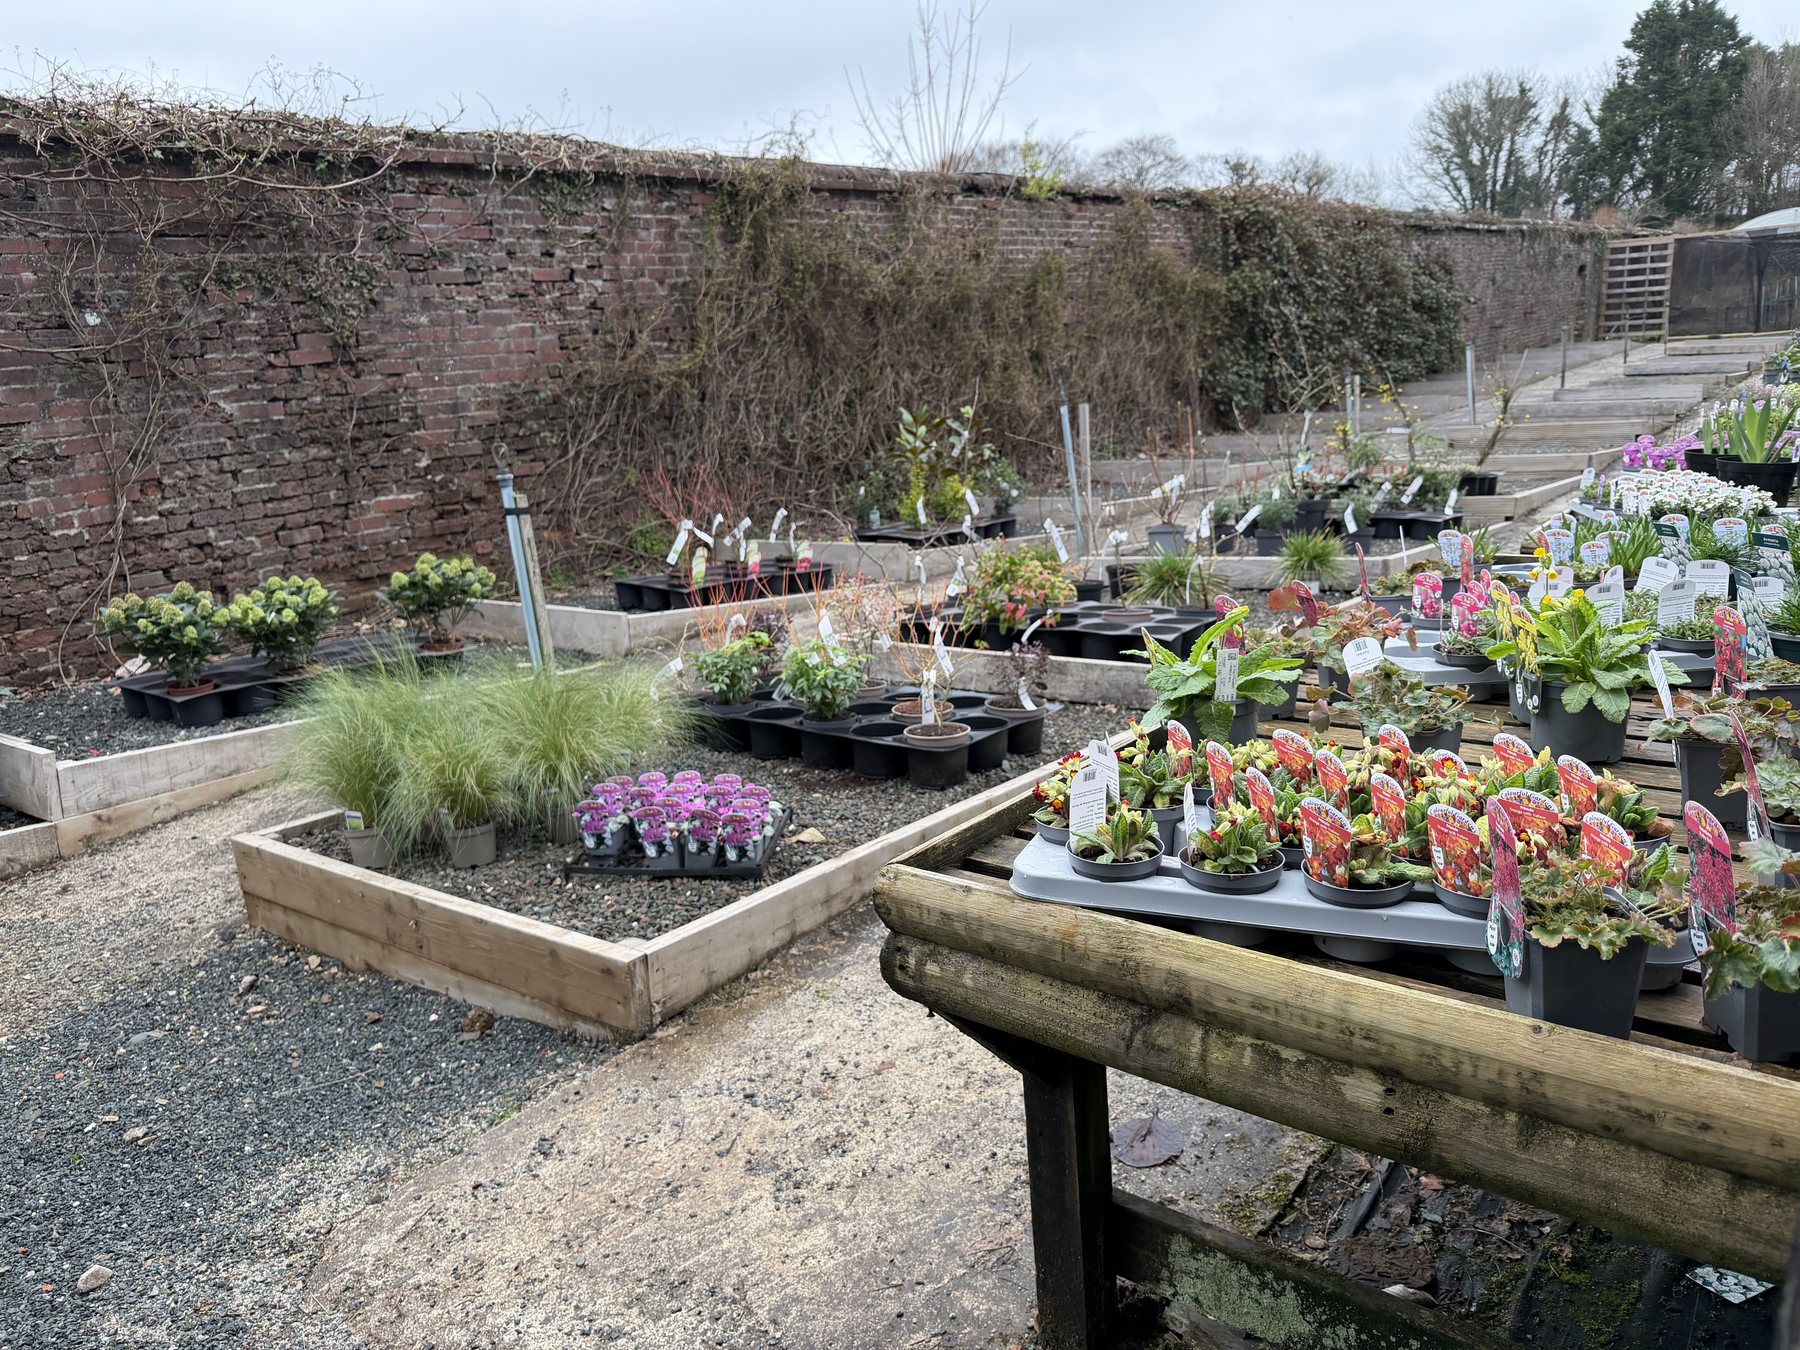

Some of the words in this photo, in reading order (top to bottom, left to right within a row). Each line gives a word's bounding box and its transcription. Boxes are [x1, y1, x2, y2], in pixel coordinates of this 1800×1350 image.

[1500, 790, 1530, 799] Colourful
[1429, 807, 1454, 815] Colourful
[1585, 815, 1610, 825] Colourful
